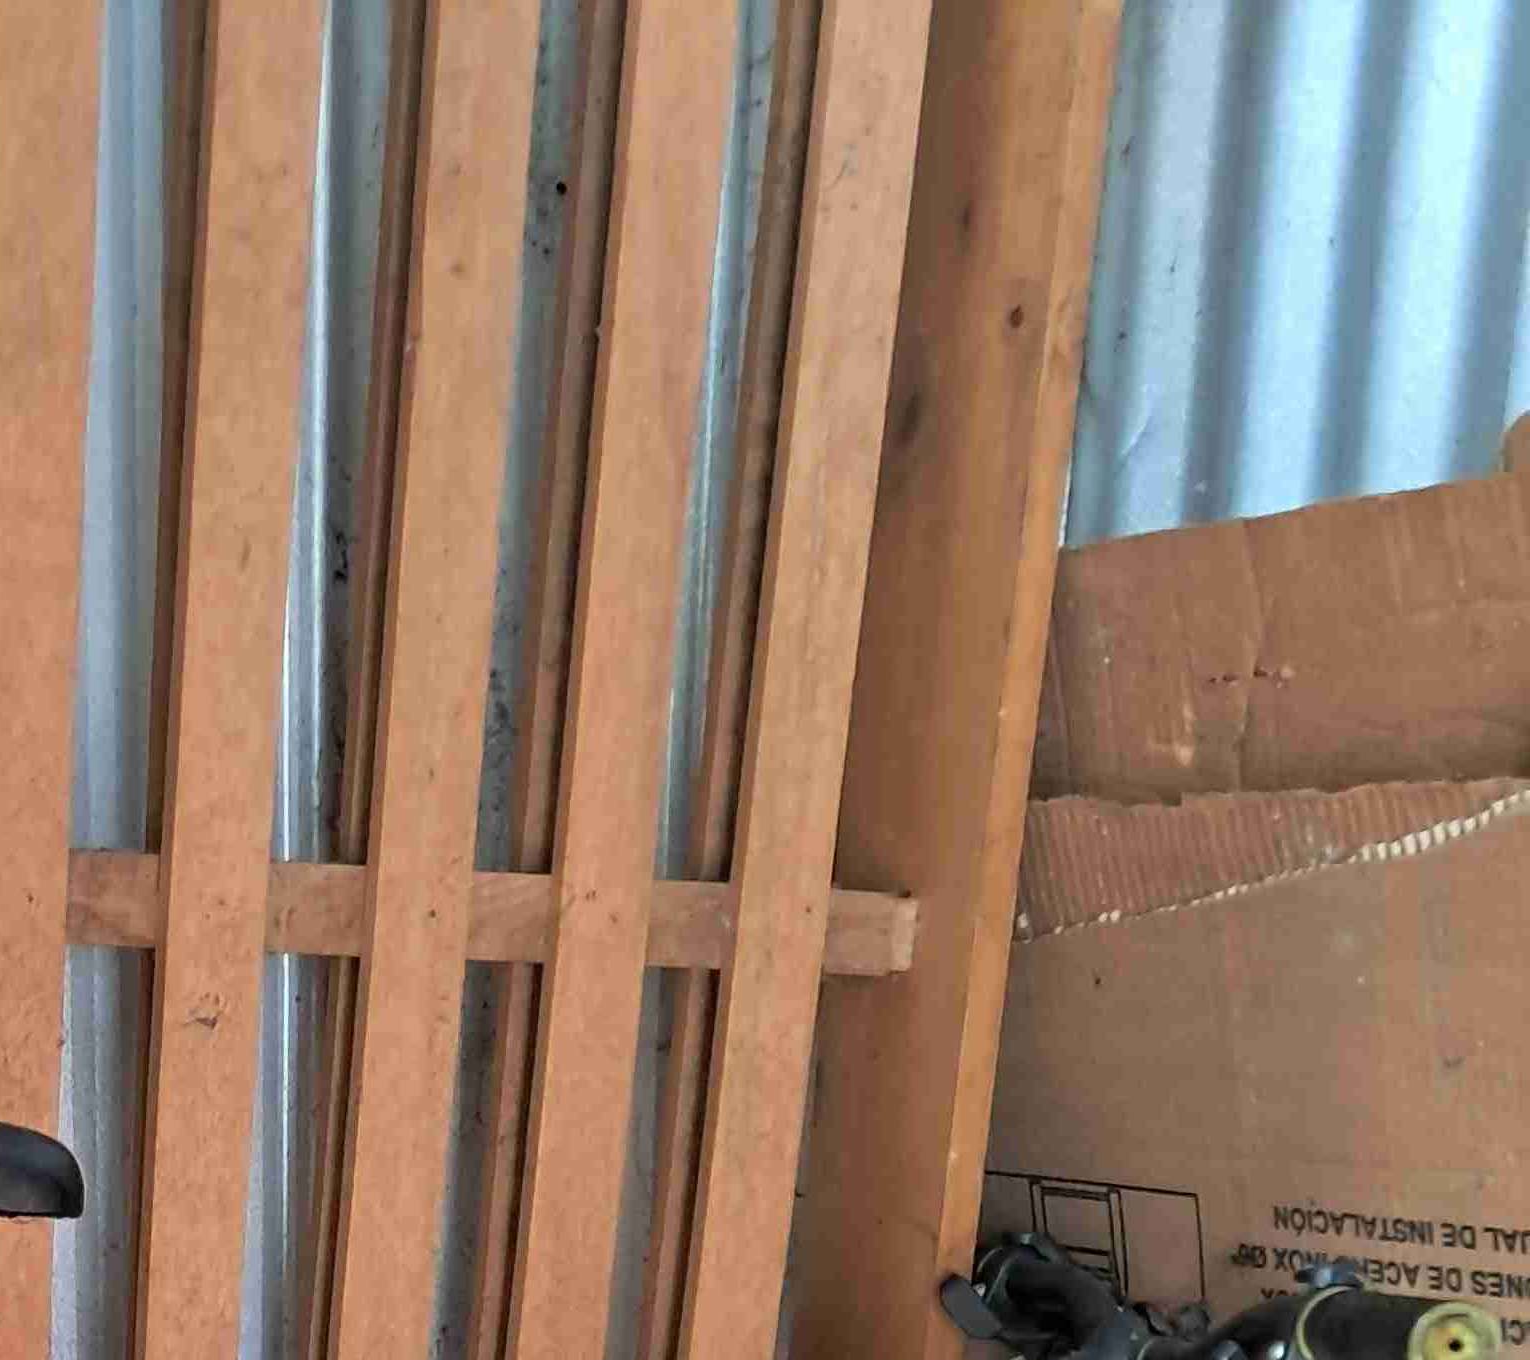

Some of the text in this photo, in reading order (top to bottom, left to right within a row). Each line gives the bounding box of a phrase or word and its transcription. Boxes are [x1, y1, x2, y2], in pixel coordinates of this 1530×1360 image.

[1274, 1206, 1434, 1244] INSTALACIÓN
[1440, 1224, 1476, 1250] DE
[1427, 1265, 1462, 1293] DE
